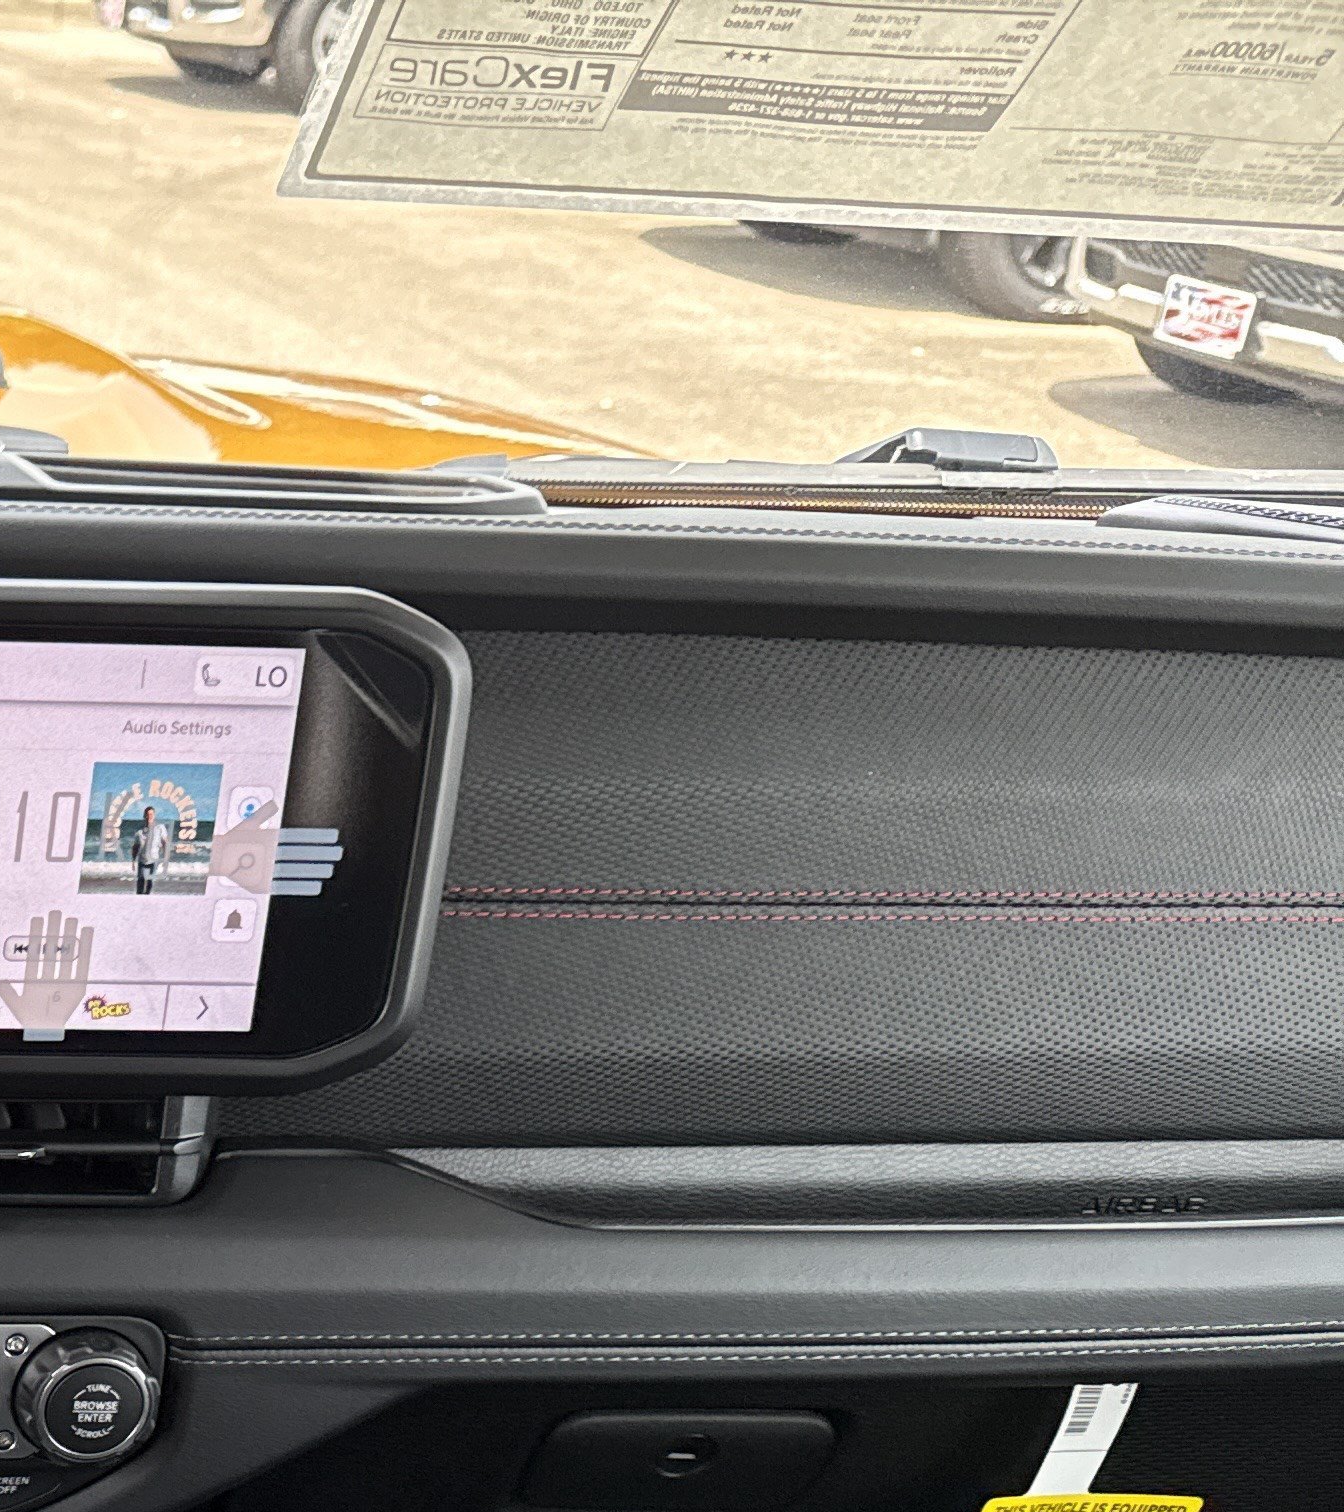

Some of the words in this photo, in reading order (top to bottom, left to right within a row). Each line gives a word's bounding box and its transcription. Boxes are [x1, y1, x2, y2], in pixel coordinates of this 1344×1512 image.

[255, 665, 288, 689] LO
[122, 719, 168, 736] Audio
[170, 721, 232, 739] Settings
[85, 1384, 112, 1394] TUNE
[73, 1400, 118, 1411] BROWSE
[77, 1413, 113, 1423] ENTER
[74, 1426, 111, 1438] SCROLL
